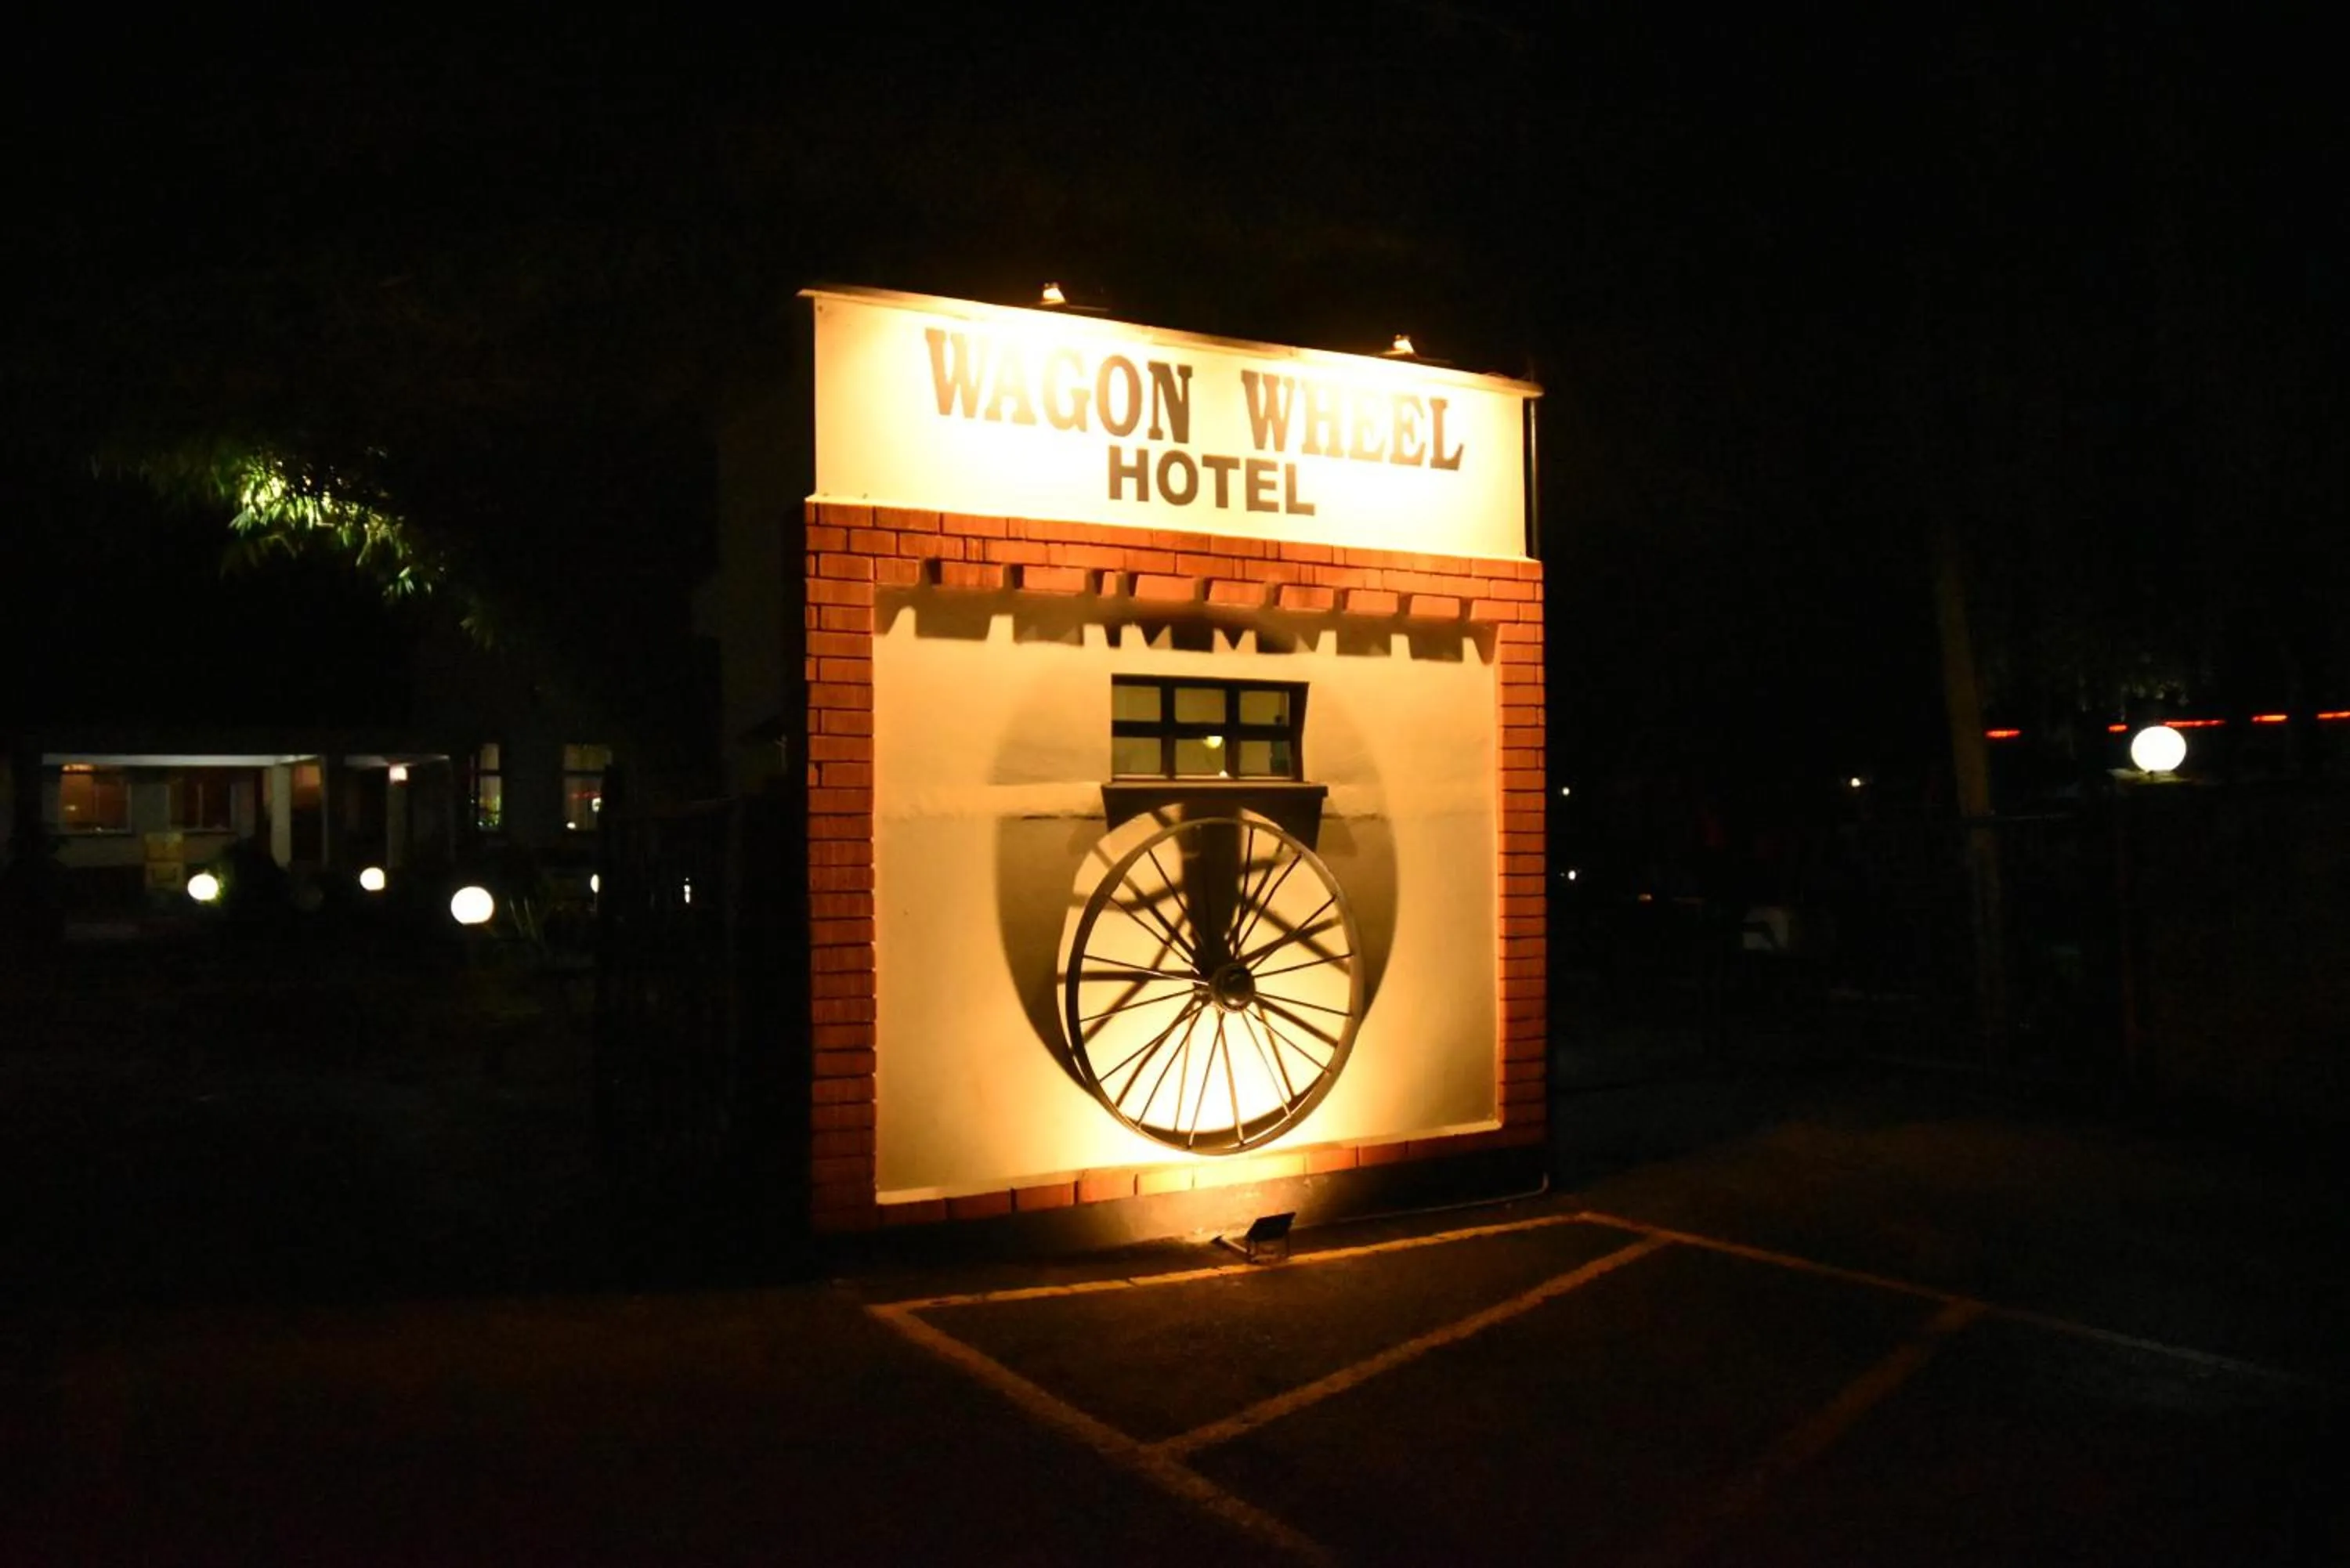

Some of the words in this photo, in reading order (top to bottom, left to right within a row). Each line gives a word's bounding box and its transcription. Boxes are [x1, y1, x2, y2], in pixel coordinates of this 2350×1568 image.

[925, 329, 1192, 444] WAGON
[1242, 370, 1463, 471] WHEEL
[1108, 446, 1315, 515] HOTEL
